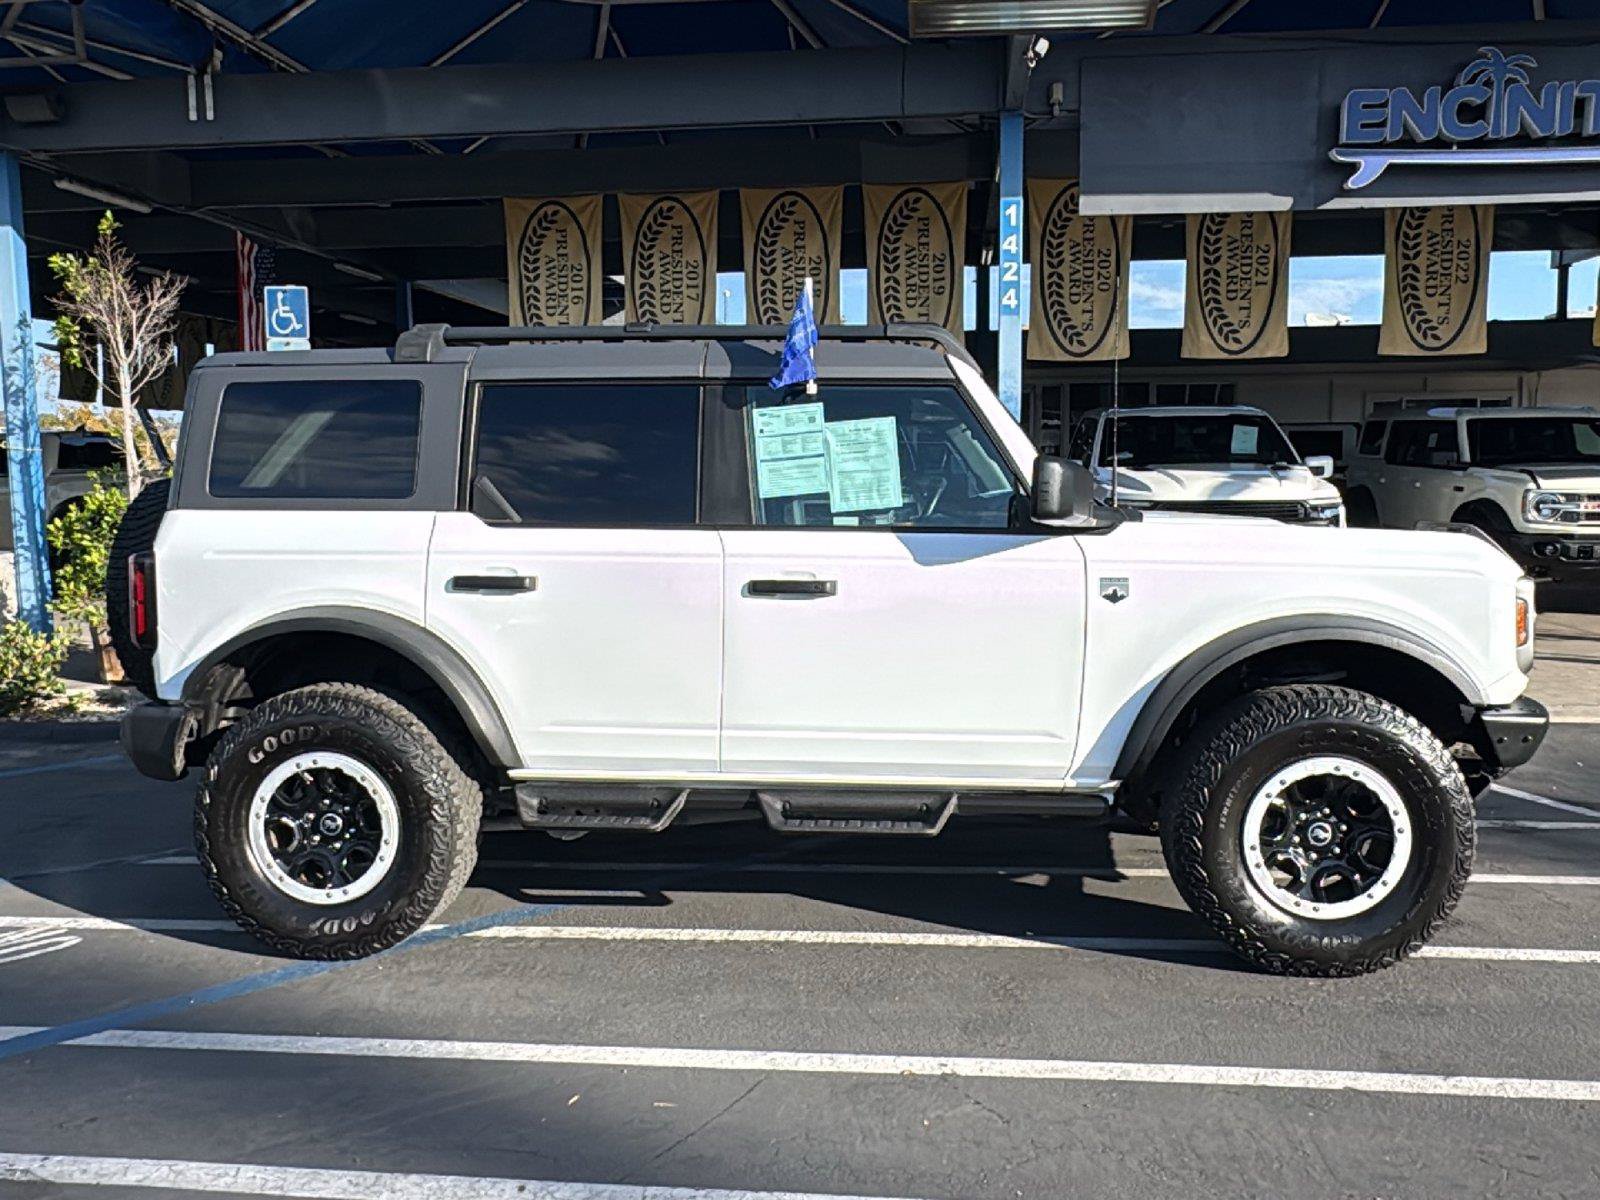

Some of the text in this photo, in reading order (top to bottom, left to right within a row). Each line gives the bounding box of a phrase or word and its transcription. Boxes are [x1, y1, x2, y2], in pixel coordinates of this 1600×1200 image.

[544, 255, 558, 318] AWARD
[555, 228, 570, 326] PRESIDENT
[570, 263, 584, 305] 2016
[659, 250, 672, 315] AWARD
[671, 224, 684, 324] PRESIDENT
[685, 260, 700, 302] 2017
[781, 246, 794, 311] AWARD
[905, 243, 918, 309] AWARD
[917, 217, 930, 322] PRESIDENT
[932, 252, 946, 295] 2019
[1001, 206, 1018, 308] 1424
[1069, 238, 1083, 305] AWARD
[1097, 248, 1111, 292] 2020
[1226, 235, 1240, 301] AWARD
[1255, 243, 1270, 288] 2021
[1426, 229, 1440, 298] AWARD
[1455, 238, 1471, 285] 2022
